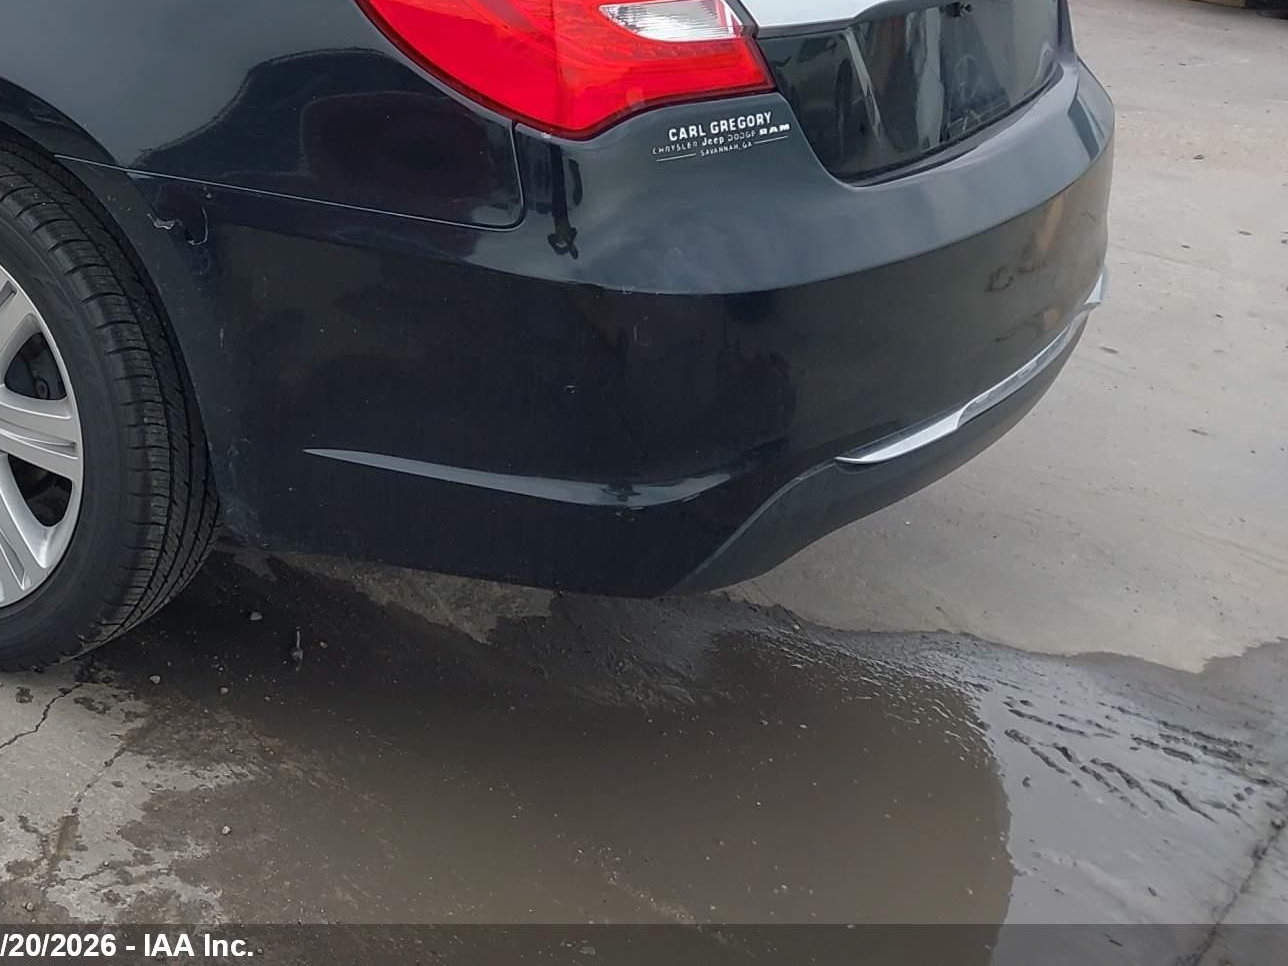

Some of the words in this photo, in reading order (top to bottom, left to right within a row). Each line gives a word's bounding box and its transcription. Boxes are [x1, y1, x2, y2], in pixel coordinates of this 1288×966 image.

[668, 124, 707, 142] CARL
[710, 111, 772, 135] GREGORY
[701, 136, 725, 147] Jeep
[759, 123, 791, 136] RAM
[742, 141, 753, 149] GA
